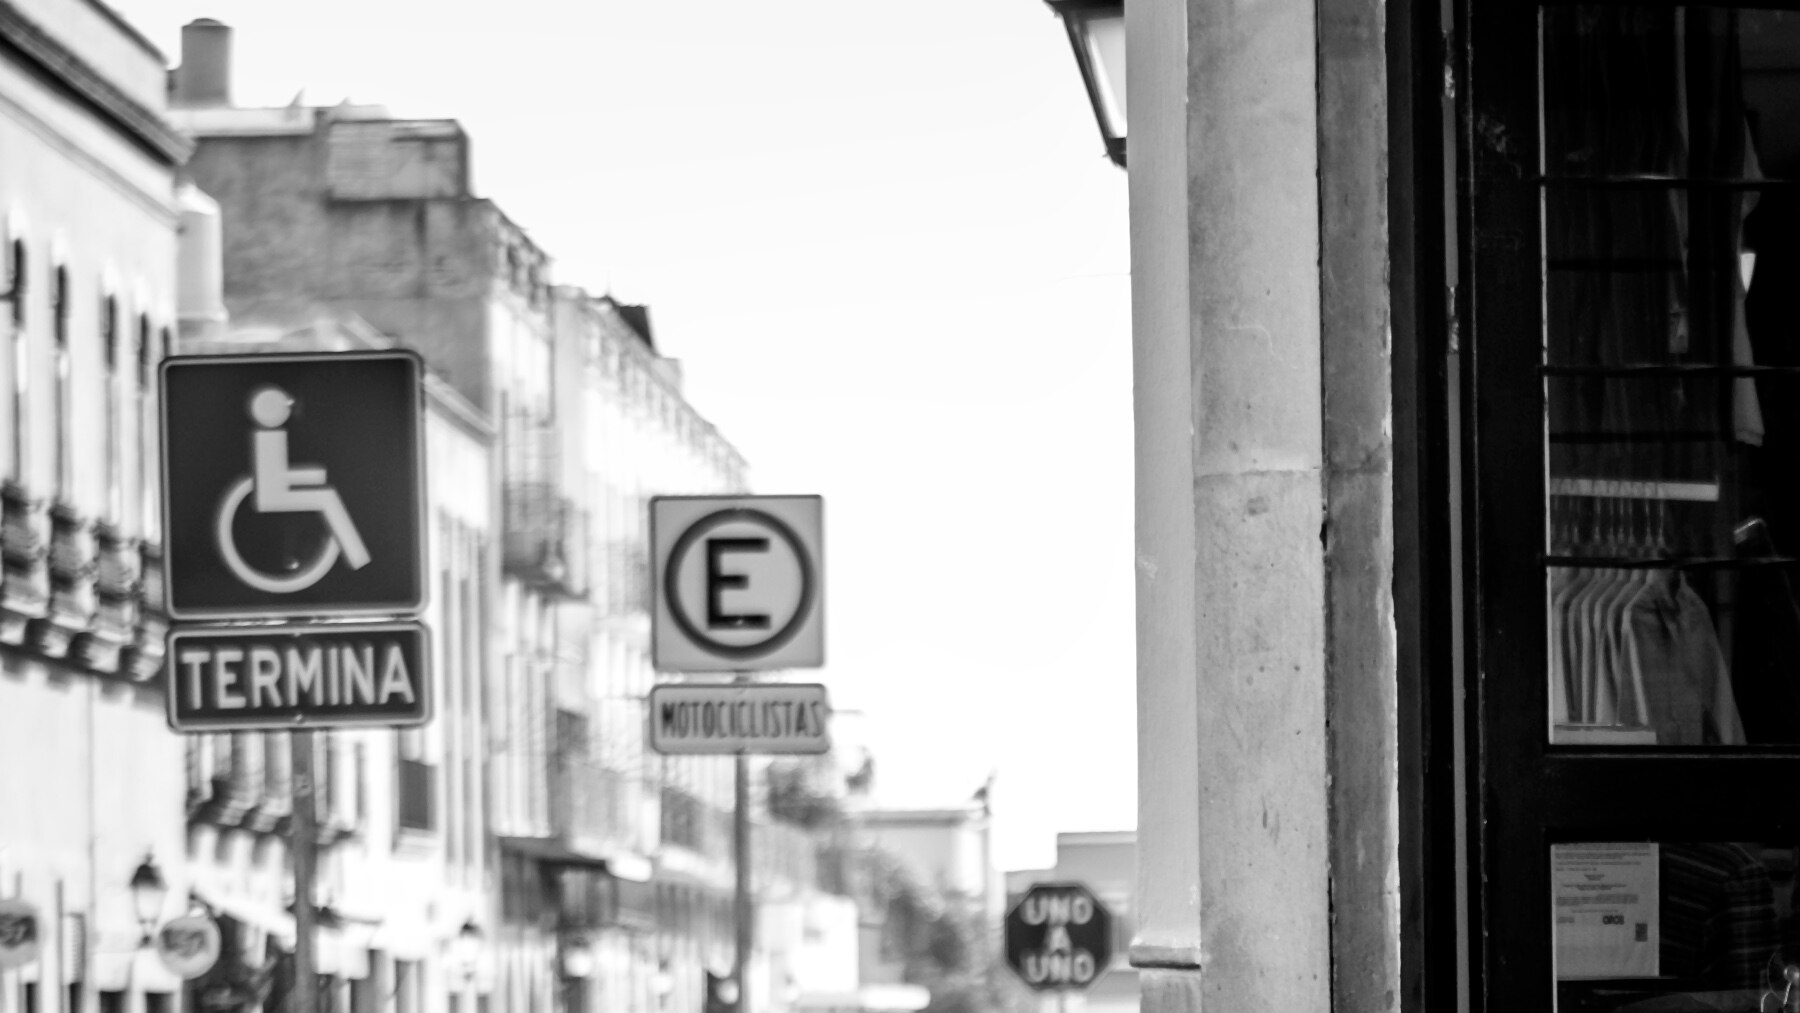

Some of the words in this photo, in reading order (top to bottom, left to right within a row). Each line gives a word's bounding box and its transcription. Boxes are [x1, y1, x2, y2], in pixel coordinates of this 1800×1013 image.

[705, 535, 772, 631] E
[180, 643, 416, 709] TERMINA
[661, 699, 825, 740] MOTOCICLISTAS
[1023, 896, 1095, 926] UNO
[1047, 925, 1072, 955] A
[1024, 953, 1096, 984] UNO
